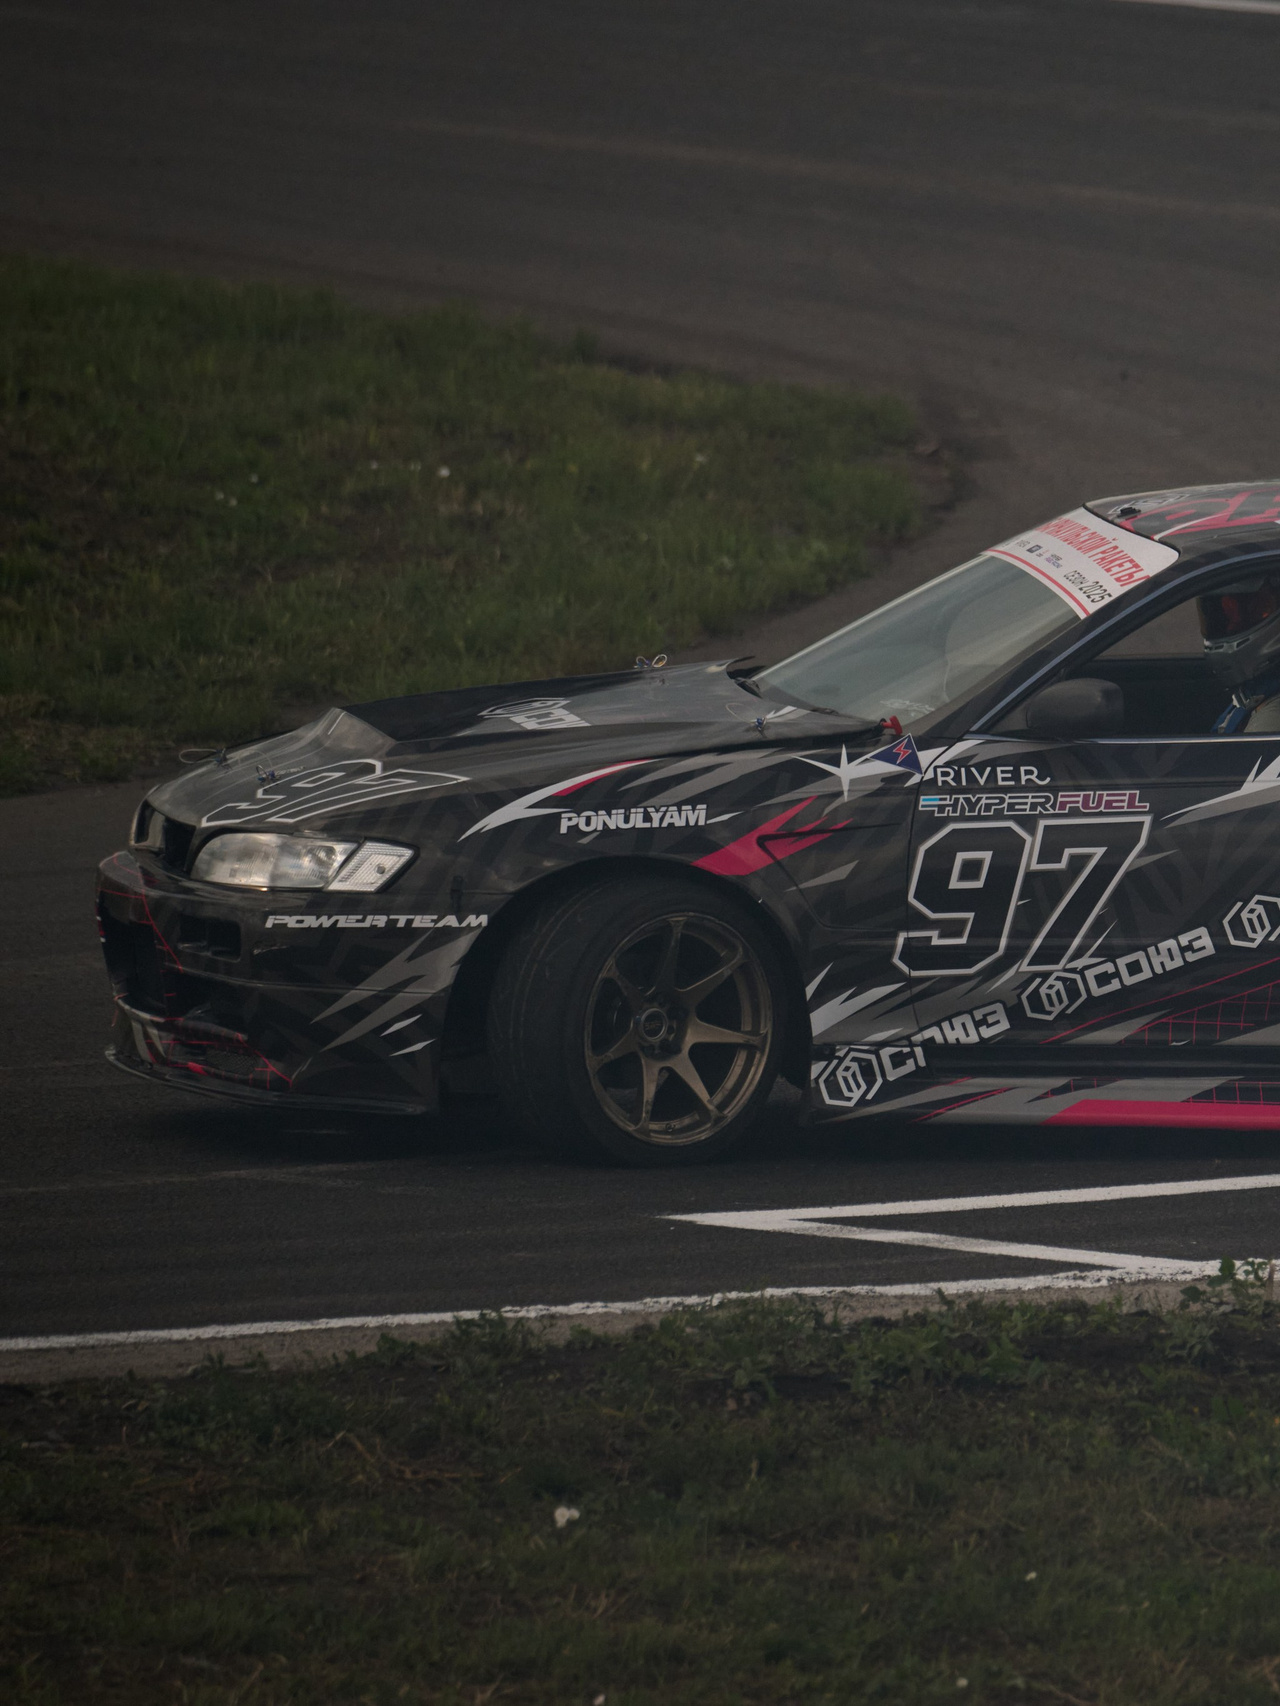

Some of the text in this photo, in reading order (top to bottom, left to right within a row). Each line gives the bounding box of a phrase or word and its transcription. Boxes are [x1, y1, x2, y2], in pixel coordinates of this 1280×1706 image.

[1087, 545, 1151, 587] РАКЕТЫ
[1078, 581, 1113, 603] 2025
[201, 758, 472, 829] 97
[936, 765, 1051, 787] RIVER
[559, 804, 707, 835] PONULYAM
[918, 790, 1150, 817] HYPERFUEL
[891, 813, 1154, 979] 97
[1084, 926, 1216, 997] СОЮЗ
